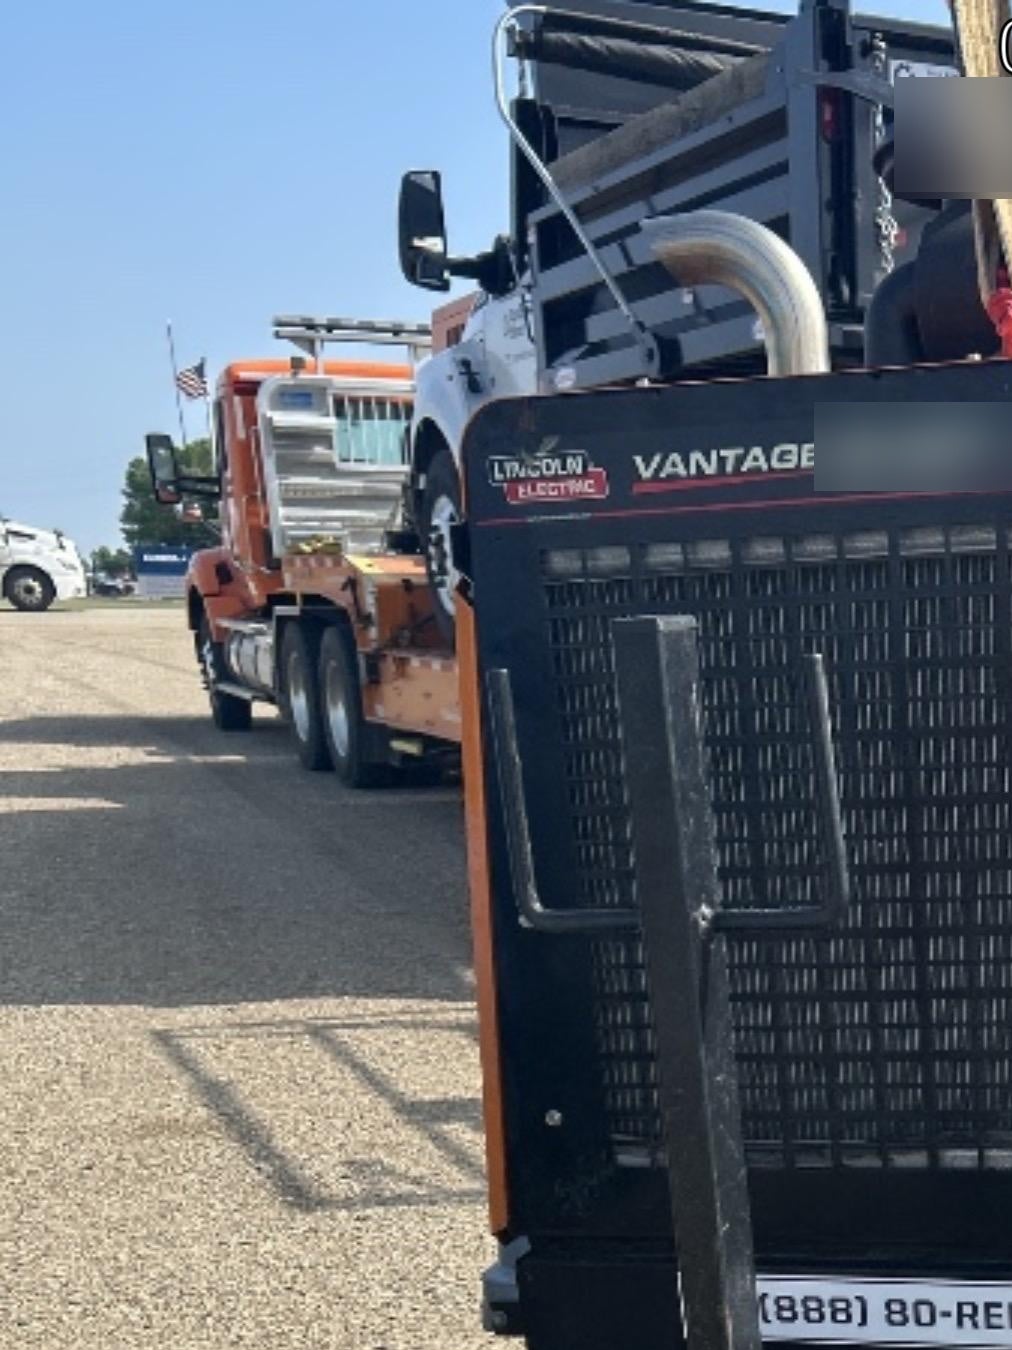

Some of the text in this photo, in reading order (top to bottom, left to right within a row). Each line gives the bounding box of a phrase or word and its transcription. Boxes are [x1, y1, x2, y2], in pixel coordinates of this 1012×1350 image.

[494, 455, 583, 480] LINCOLN
[518, 480, 595, 499] ELECTRIC
[759, 1293, 868, 1328] (888)
